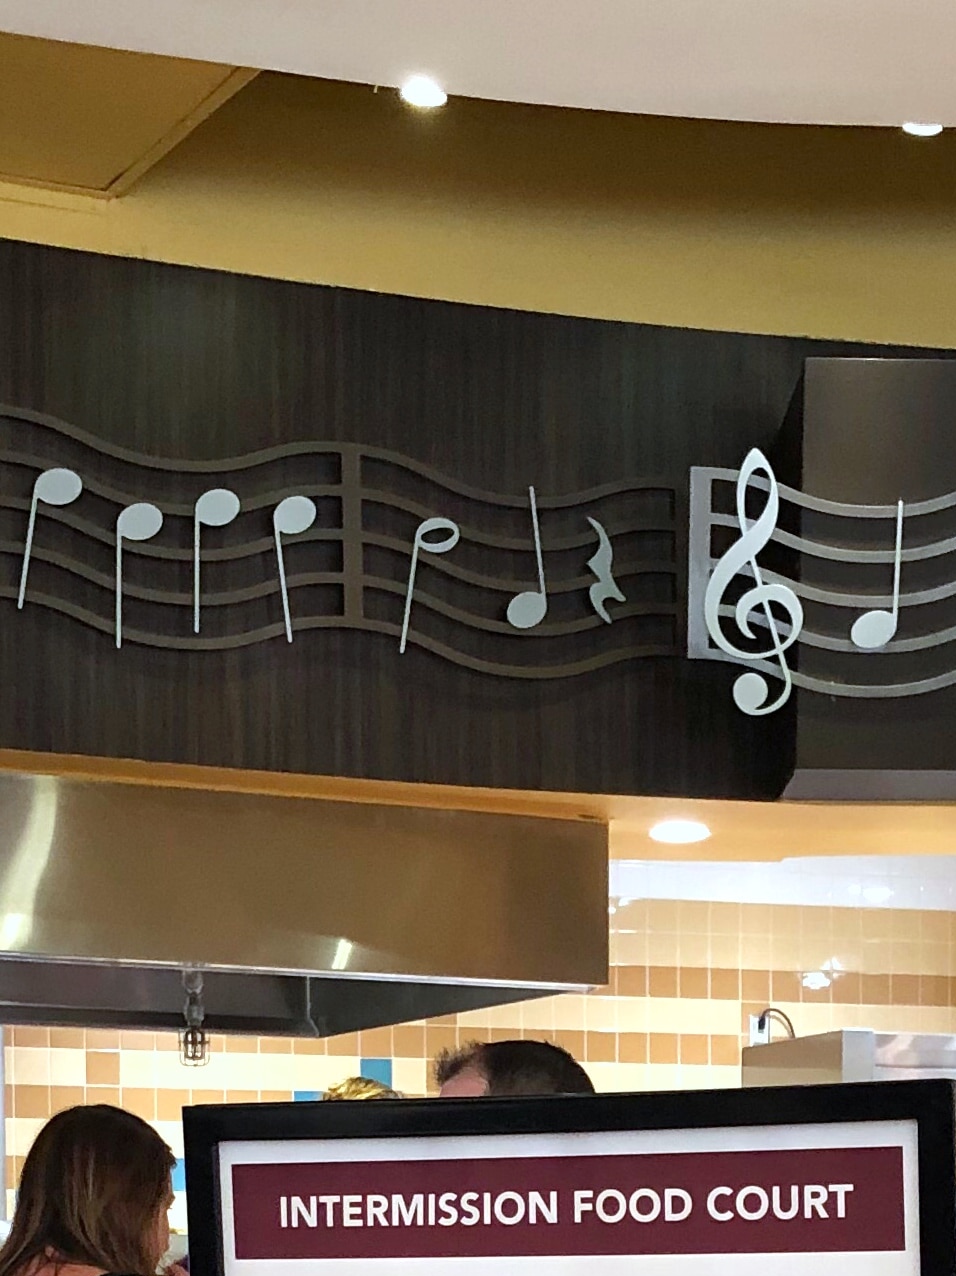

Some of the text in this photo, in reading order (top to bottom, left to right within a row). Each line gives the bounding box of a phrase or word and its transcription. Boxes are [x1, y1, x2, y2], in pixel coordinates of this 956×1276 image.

[280, 1183, 854, 1228] INTERMISSION FOOD COURT
